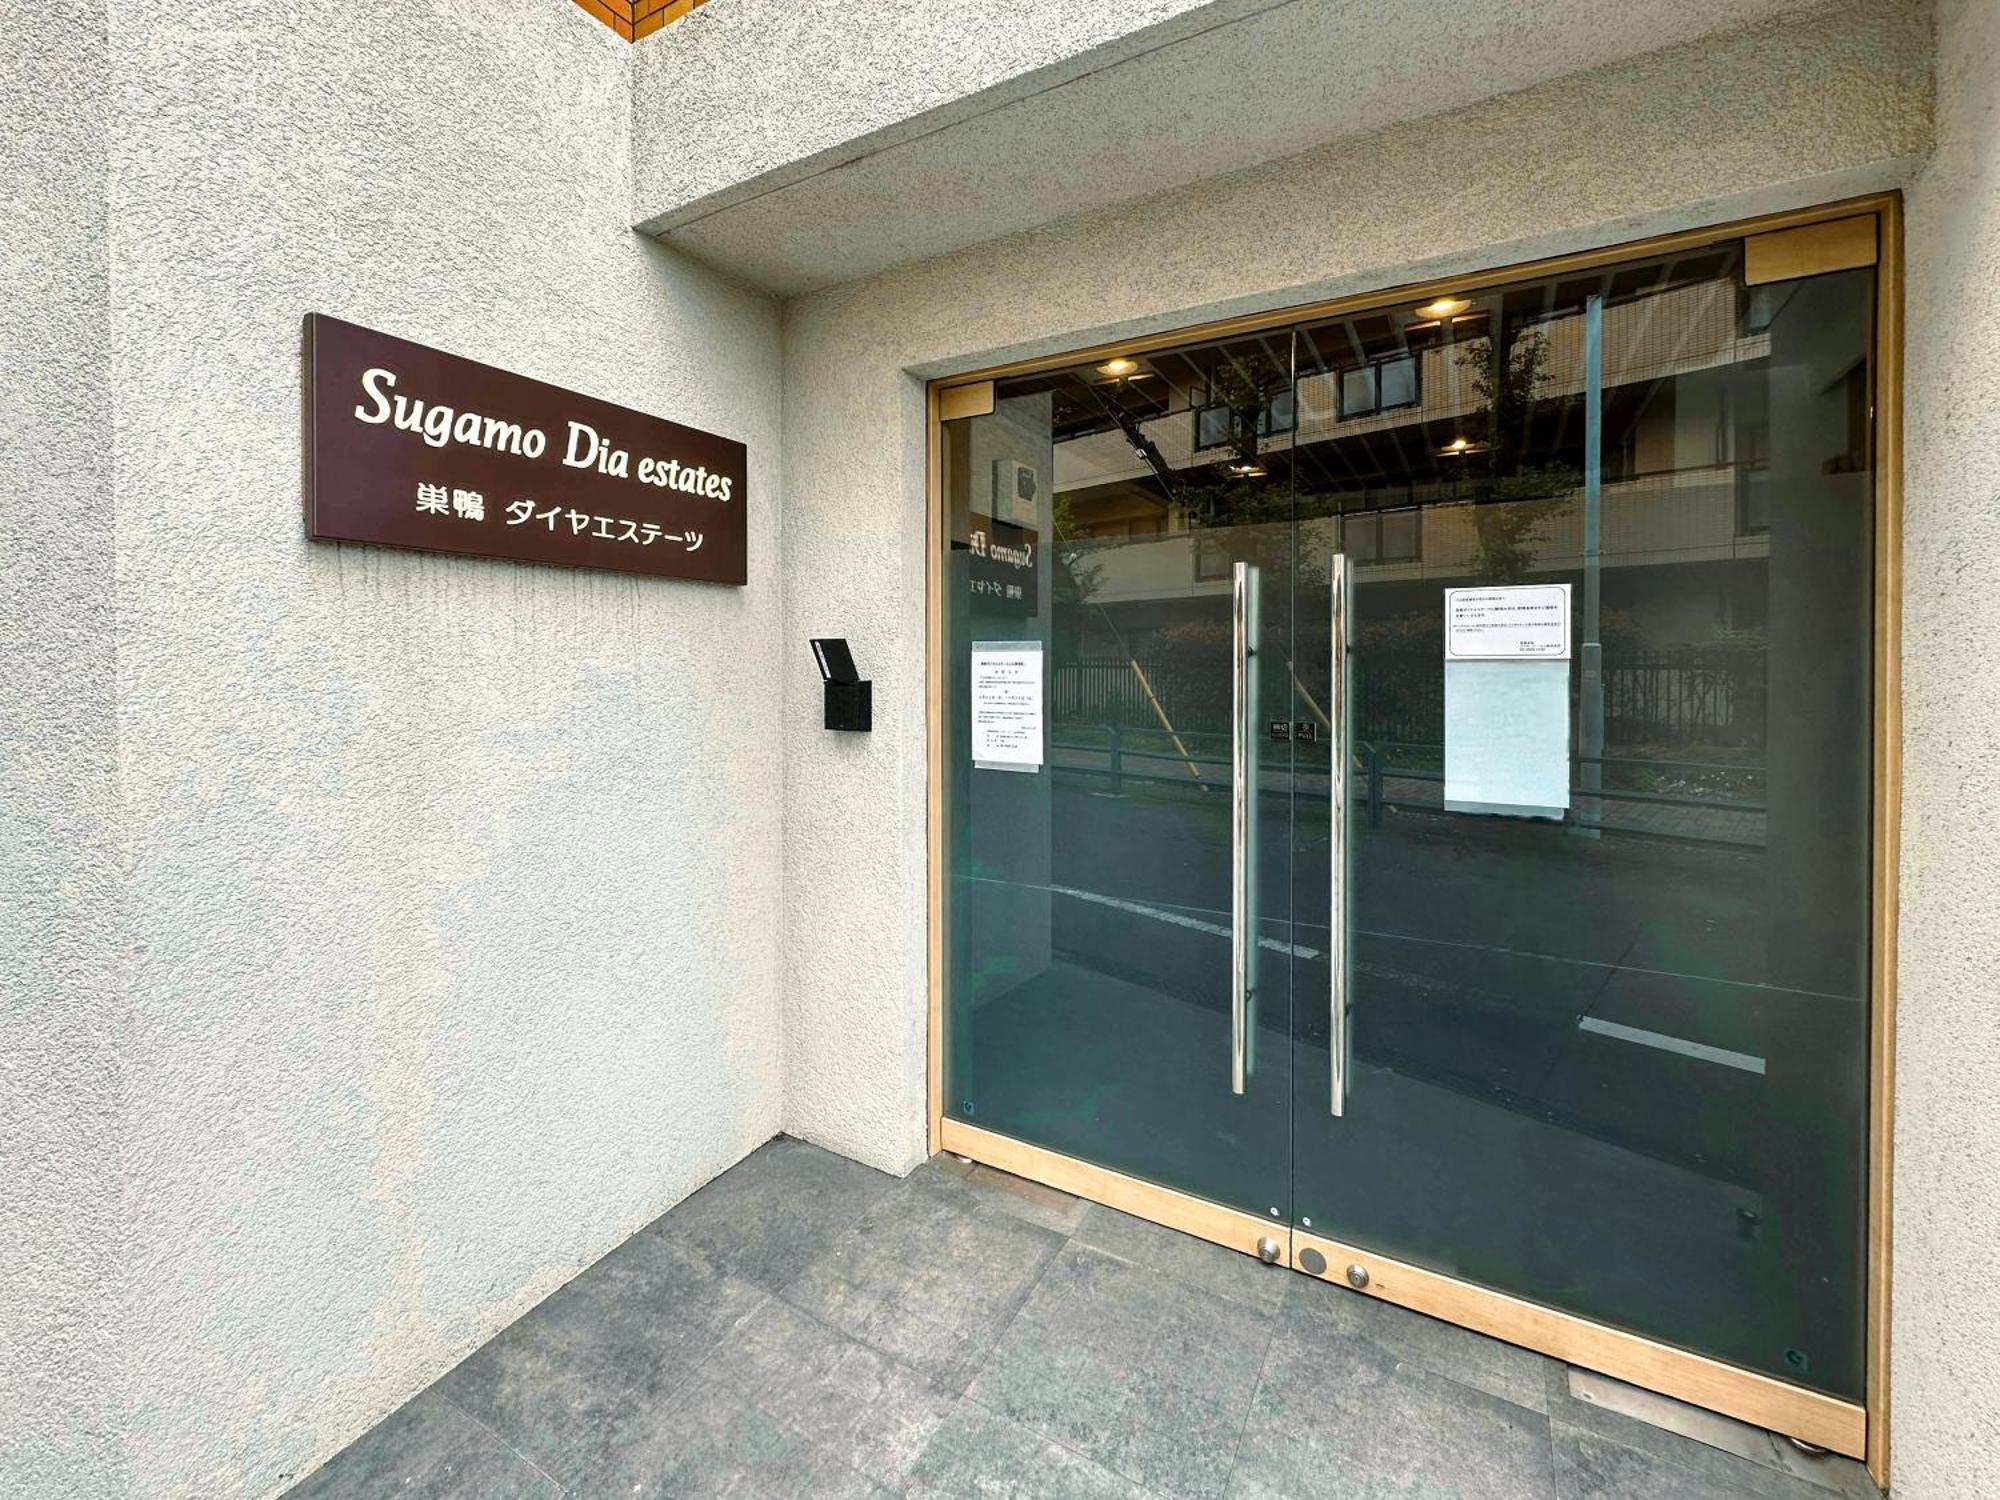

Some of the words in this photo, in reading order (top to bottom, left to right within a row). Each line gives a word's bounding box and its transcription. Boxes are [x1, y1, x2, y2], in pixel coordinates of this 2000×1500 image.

[355, 368, 547, 459] Sugamo
[562, 420, 629, 479] Dia
[637, 457, 733, 502] estates
[415, 482, 485, 522] 巣鴨
[505, 499, 704, 552] ダイヤエステーツ
